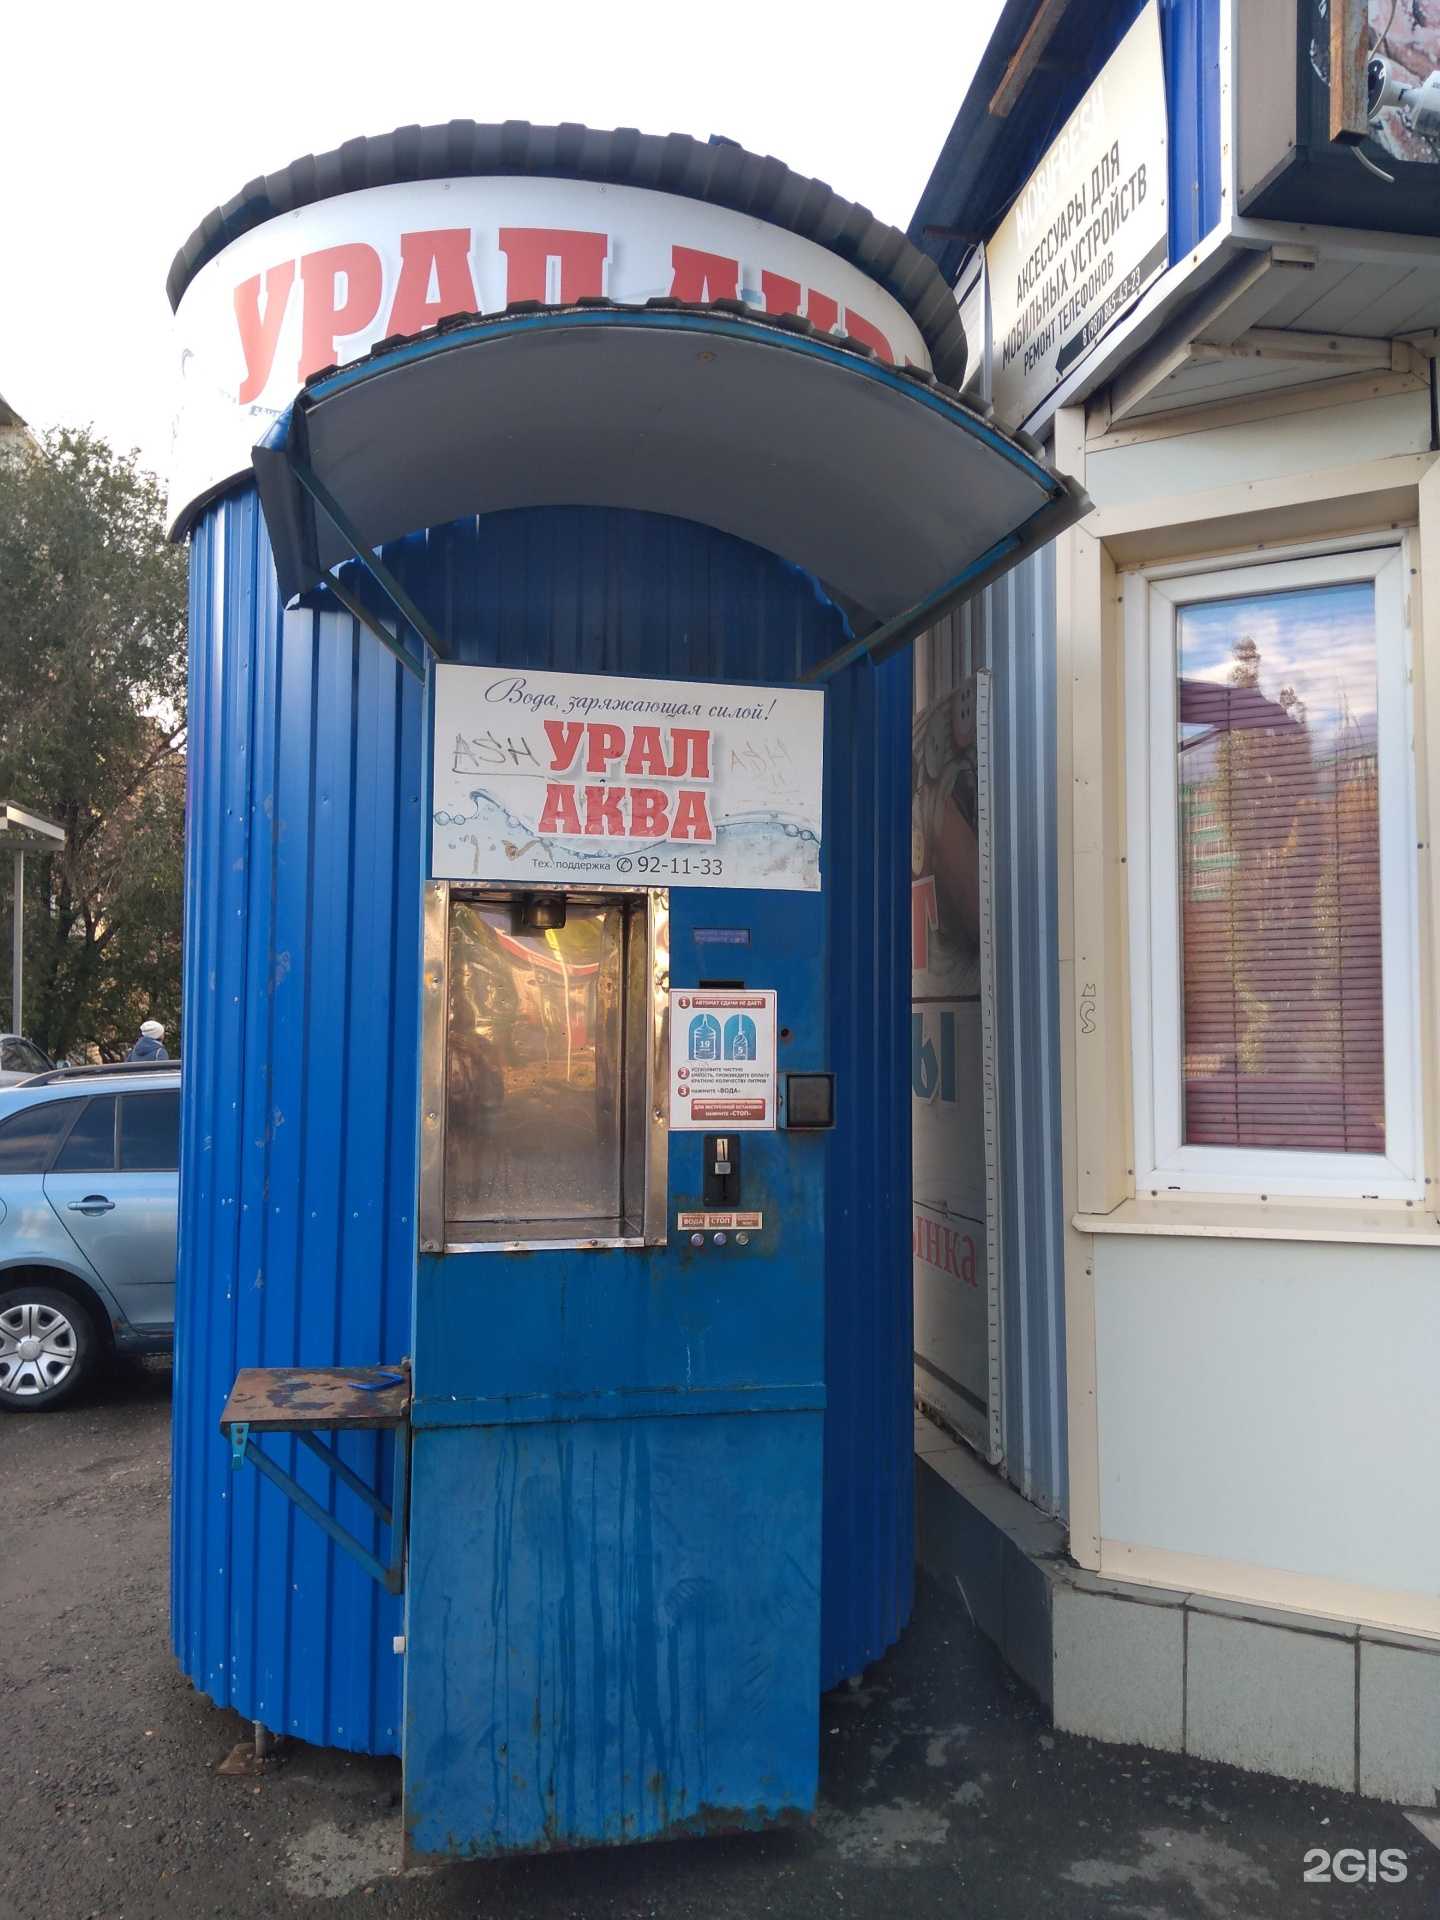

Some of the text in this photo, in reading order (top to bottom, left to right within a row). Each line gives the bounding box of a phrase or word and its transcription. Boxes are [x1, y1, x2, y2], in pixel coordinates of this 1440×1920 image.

[1016, 139, 1121, 308] АКСЕССУАРЫ ДЛЯ
[1002, 163, 1147, 370] МОБИЛЬНЫХ УСТРОЙСТВ
[1024, 251, 1114, 377] РЕМОНТ ТЕЛЕФОНОВ
[484, 677, 778, 721] Вода, заряжающая силой!
[543, 719, 711, 779] УРАЛ
[538, 783, 712, 841] АКВА
[555, 859, 611, 873] поддержка
[637, 856, 723, 876] 92-11-33
